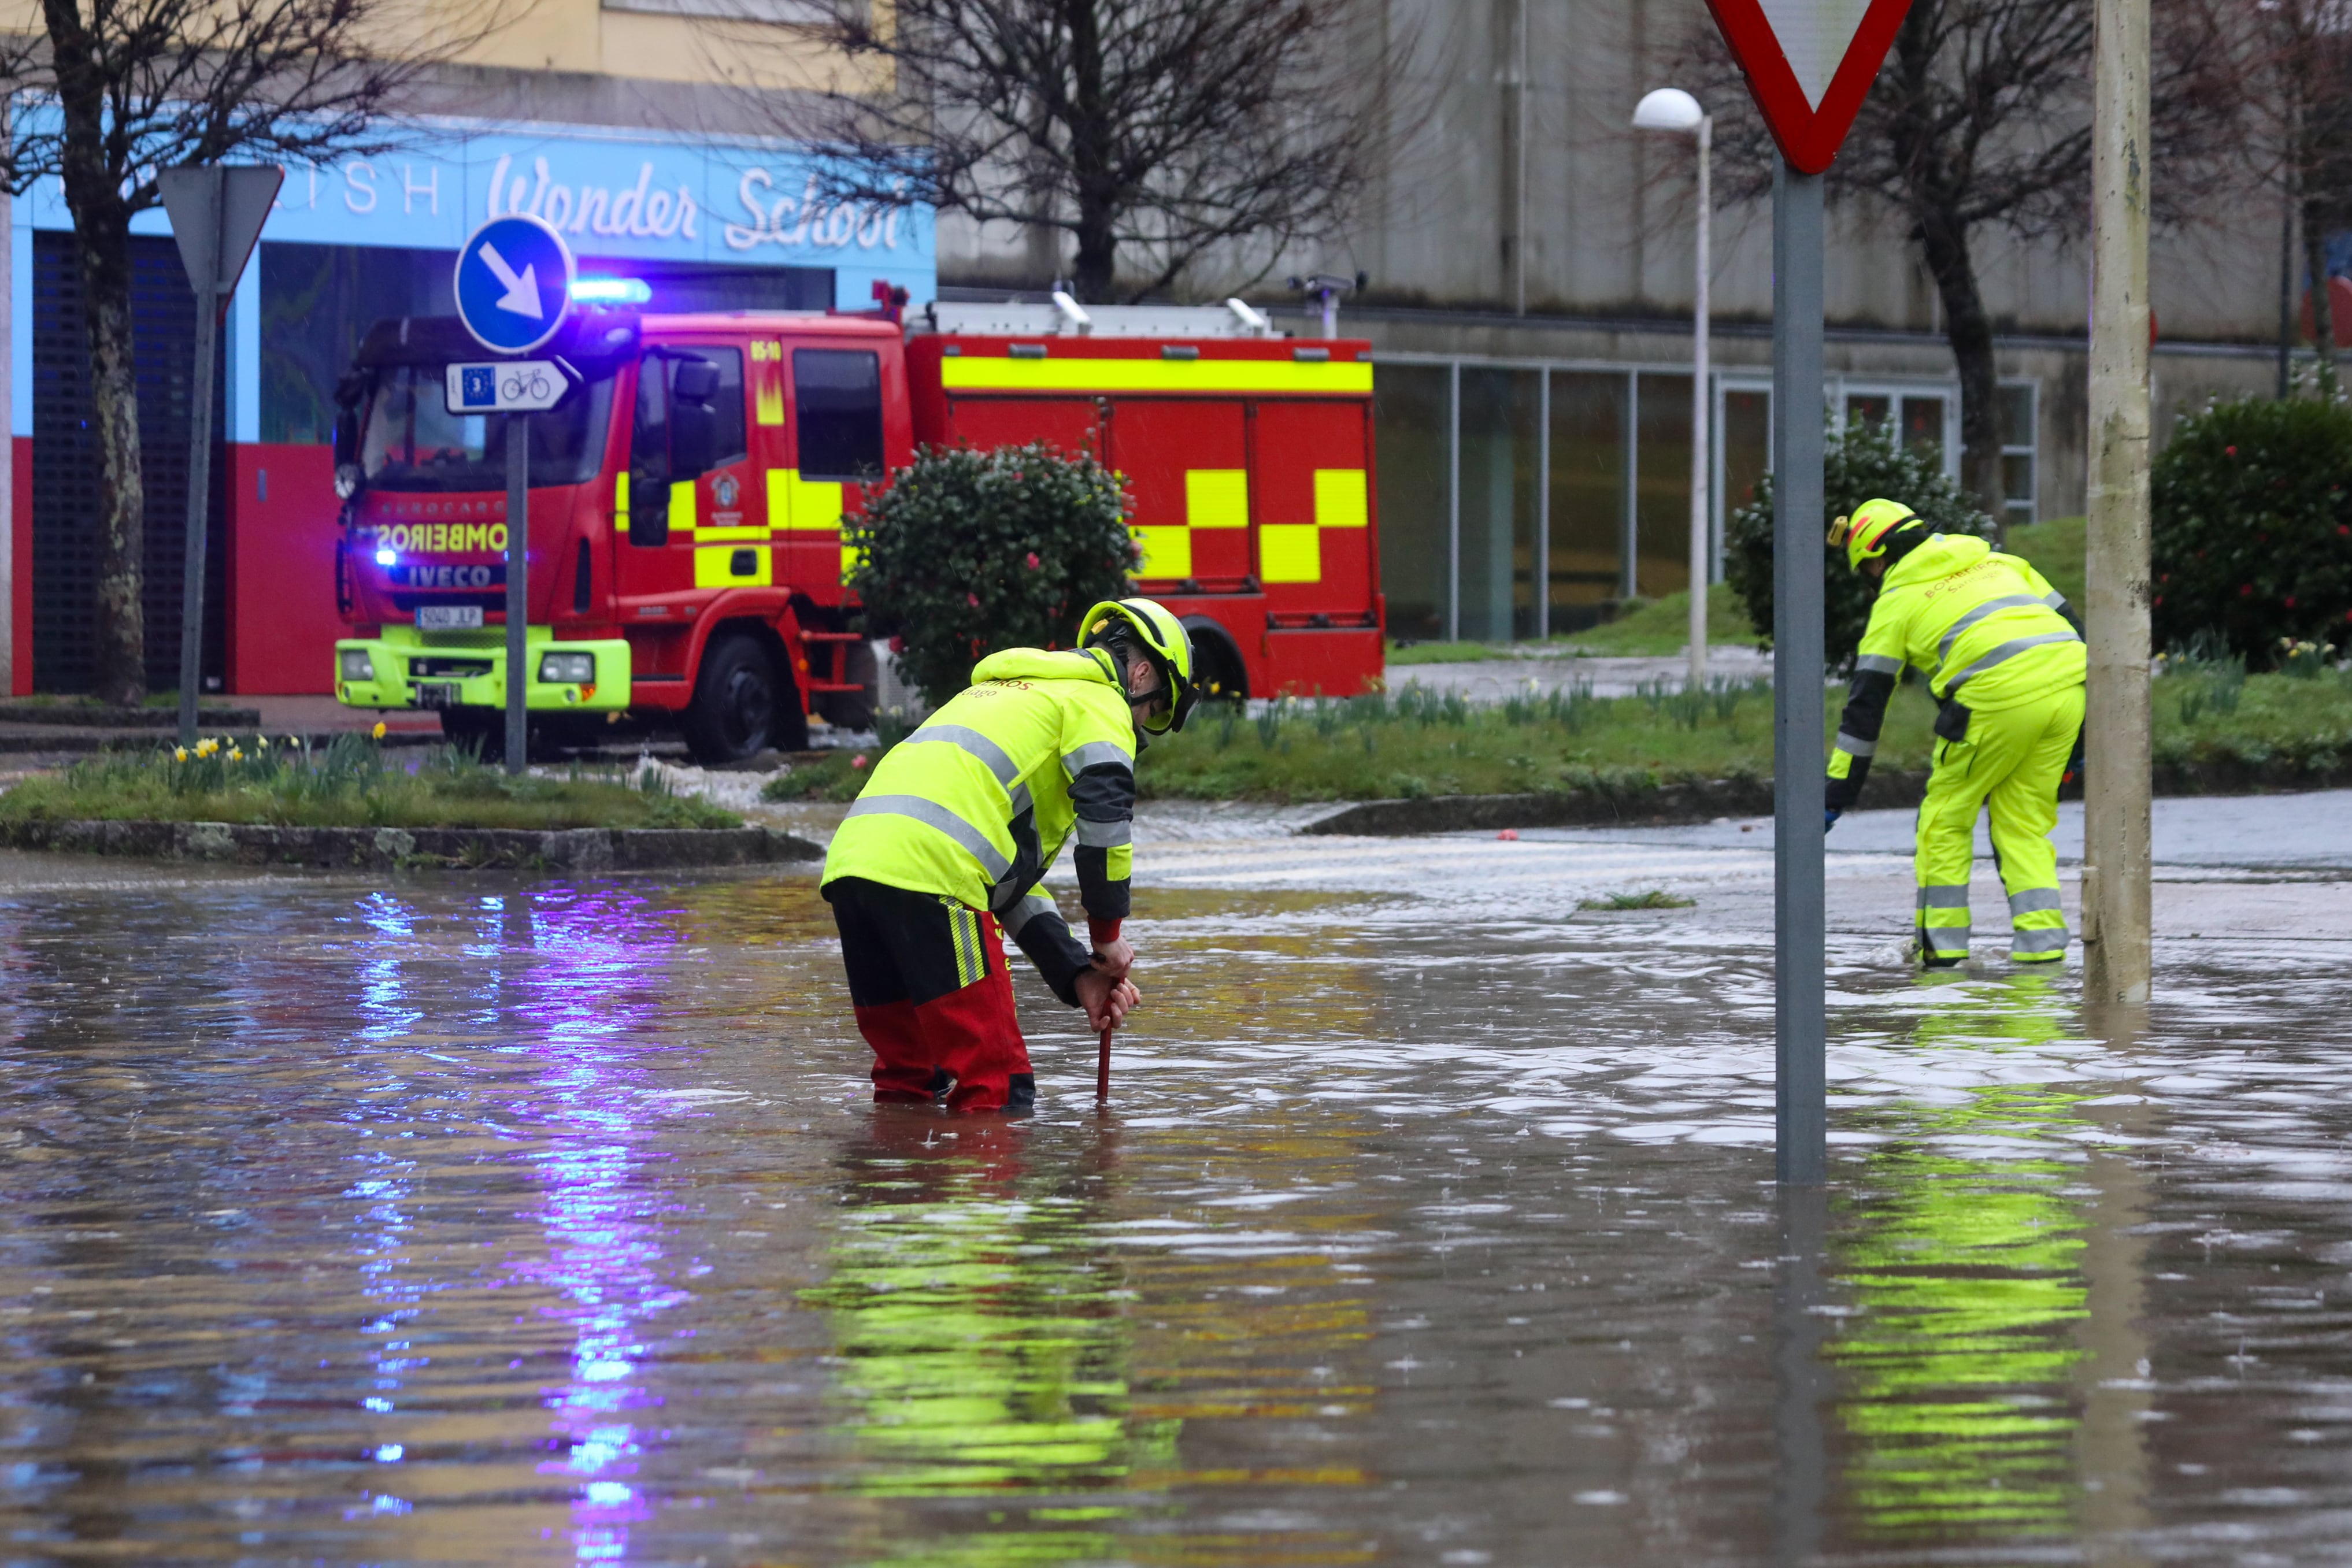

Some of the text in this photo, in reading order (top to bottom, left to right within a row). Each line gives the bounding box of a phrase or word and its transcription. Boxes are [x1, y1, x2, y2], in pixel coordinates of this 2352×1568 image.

[488, 154, 906, 250] Wonder School
[473, 377, 482, 393] 3
[409, 565, 491, 588] IVECO
[960, 687, 998, 698] tiago
[979, 679, 1034, 691] EIROS
